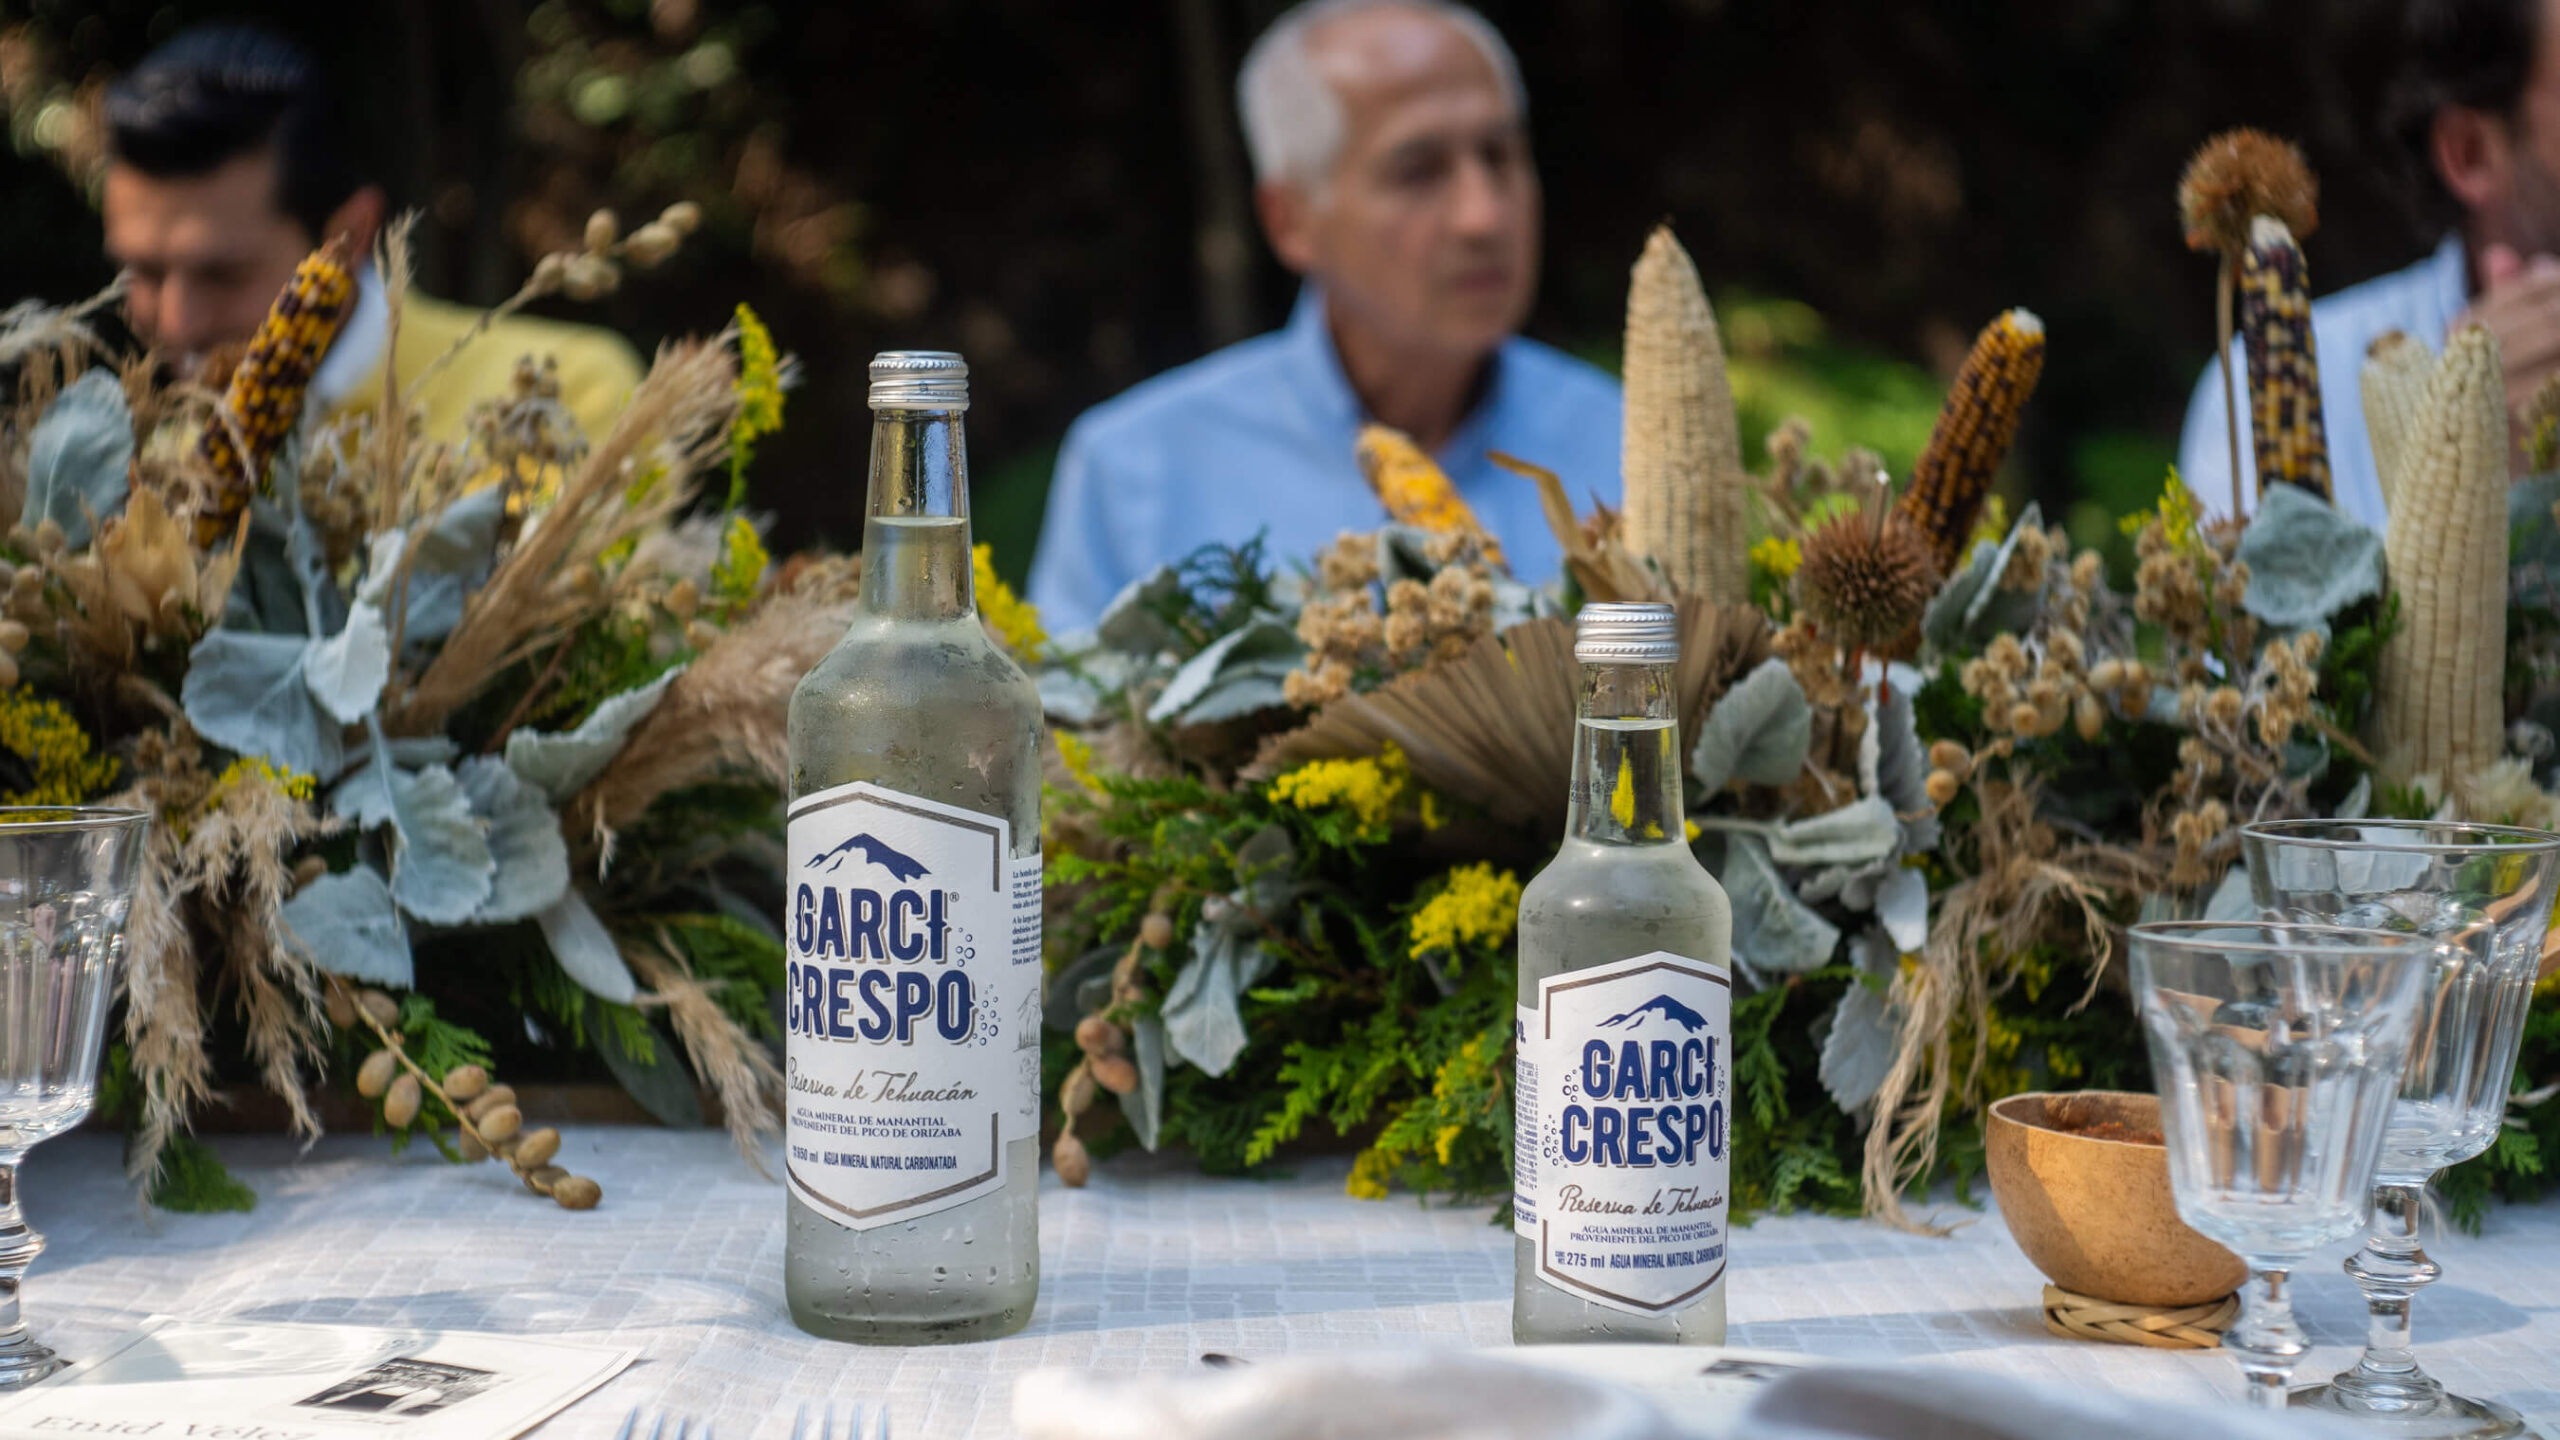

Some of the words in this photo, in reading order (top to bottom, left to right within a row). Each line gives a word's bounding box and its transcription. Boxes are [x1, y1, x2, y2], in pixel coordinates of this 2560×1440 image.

[796, 883, 950, 963] GARCI
[789, 961, 977, 1044] CRESPO
[788, 1056, 837, 1097] Reserva
[843, 1069, 868, 1100] de
[871, 1070, 978, 1103] Tehuacán
[1580, 1036, 1715, 1101] GARCI
[791, 1115, 838, 1134] PROVENIENTE
[840, 1125, 859, 1136] DEL
[862, 1127, 890, 1138] PICO
[892, 1128, 908, 1138] DE
[910, 1128, 962, 1138] ORIZABA
[797, 1107, 814, 1119] AGUA
[815, 1112, 856, 1125] MINERAL
[859, 1116, 873, 1126] DE
[876, 1117, 947, 1126] MANANTIAL
[1559, 1100, 1724, 1167] CRESPO
[823, 1151, 839, 1166] AGUA
[840, 1152, 869, 1169] MINERAL
[870, 1155, 903, 1170] NATURAL
[904, 1156, 957, 1170] CARBONATADA
[1558, 1184, 1636, 1215] Reserva
[1642, 1188, 1664, 1215] de
[1667, 1185, 1722, 1216] Tehuacán
[1570, 1232, 1637, 1244] PROVENIENTE
[1639, 1235, 1656, 1244] DEL
[1659, 1234, 1680, 1243] PICO
[1682, 1232, 1692, 1241] DE
[1582, 1225, 1609, 1234] AGUA
[1610, 1227, 1654, 1235] MINERAL
[1656, 1226, 1668, 1235] DE
[1671, 1221, 1712, 1233] MANANTIAL
[1567, 1252, 1587, 1267] 275
[1591, 1254, 1605, 1268] ml
[1610, 1254, 1631, 1269] AGUA
[1632, 1253, 1665, 1269] MINERAL
[1666, 1251, 1695, 1267] NATURAL
[31, 1416, 165, 1435] Enid
